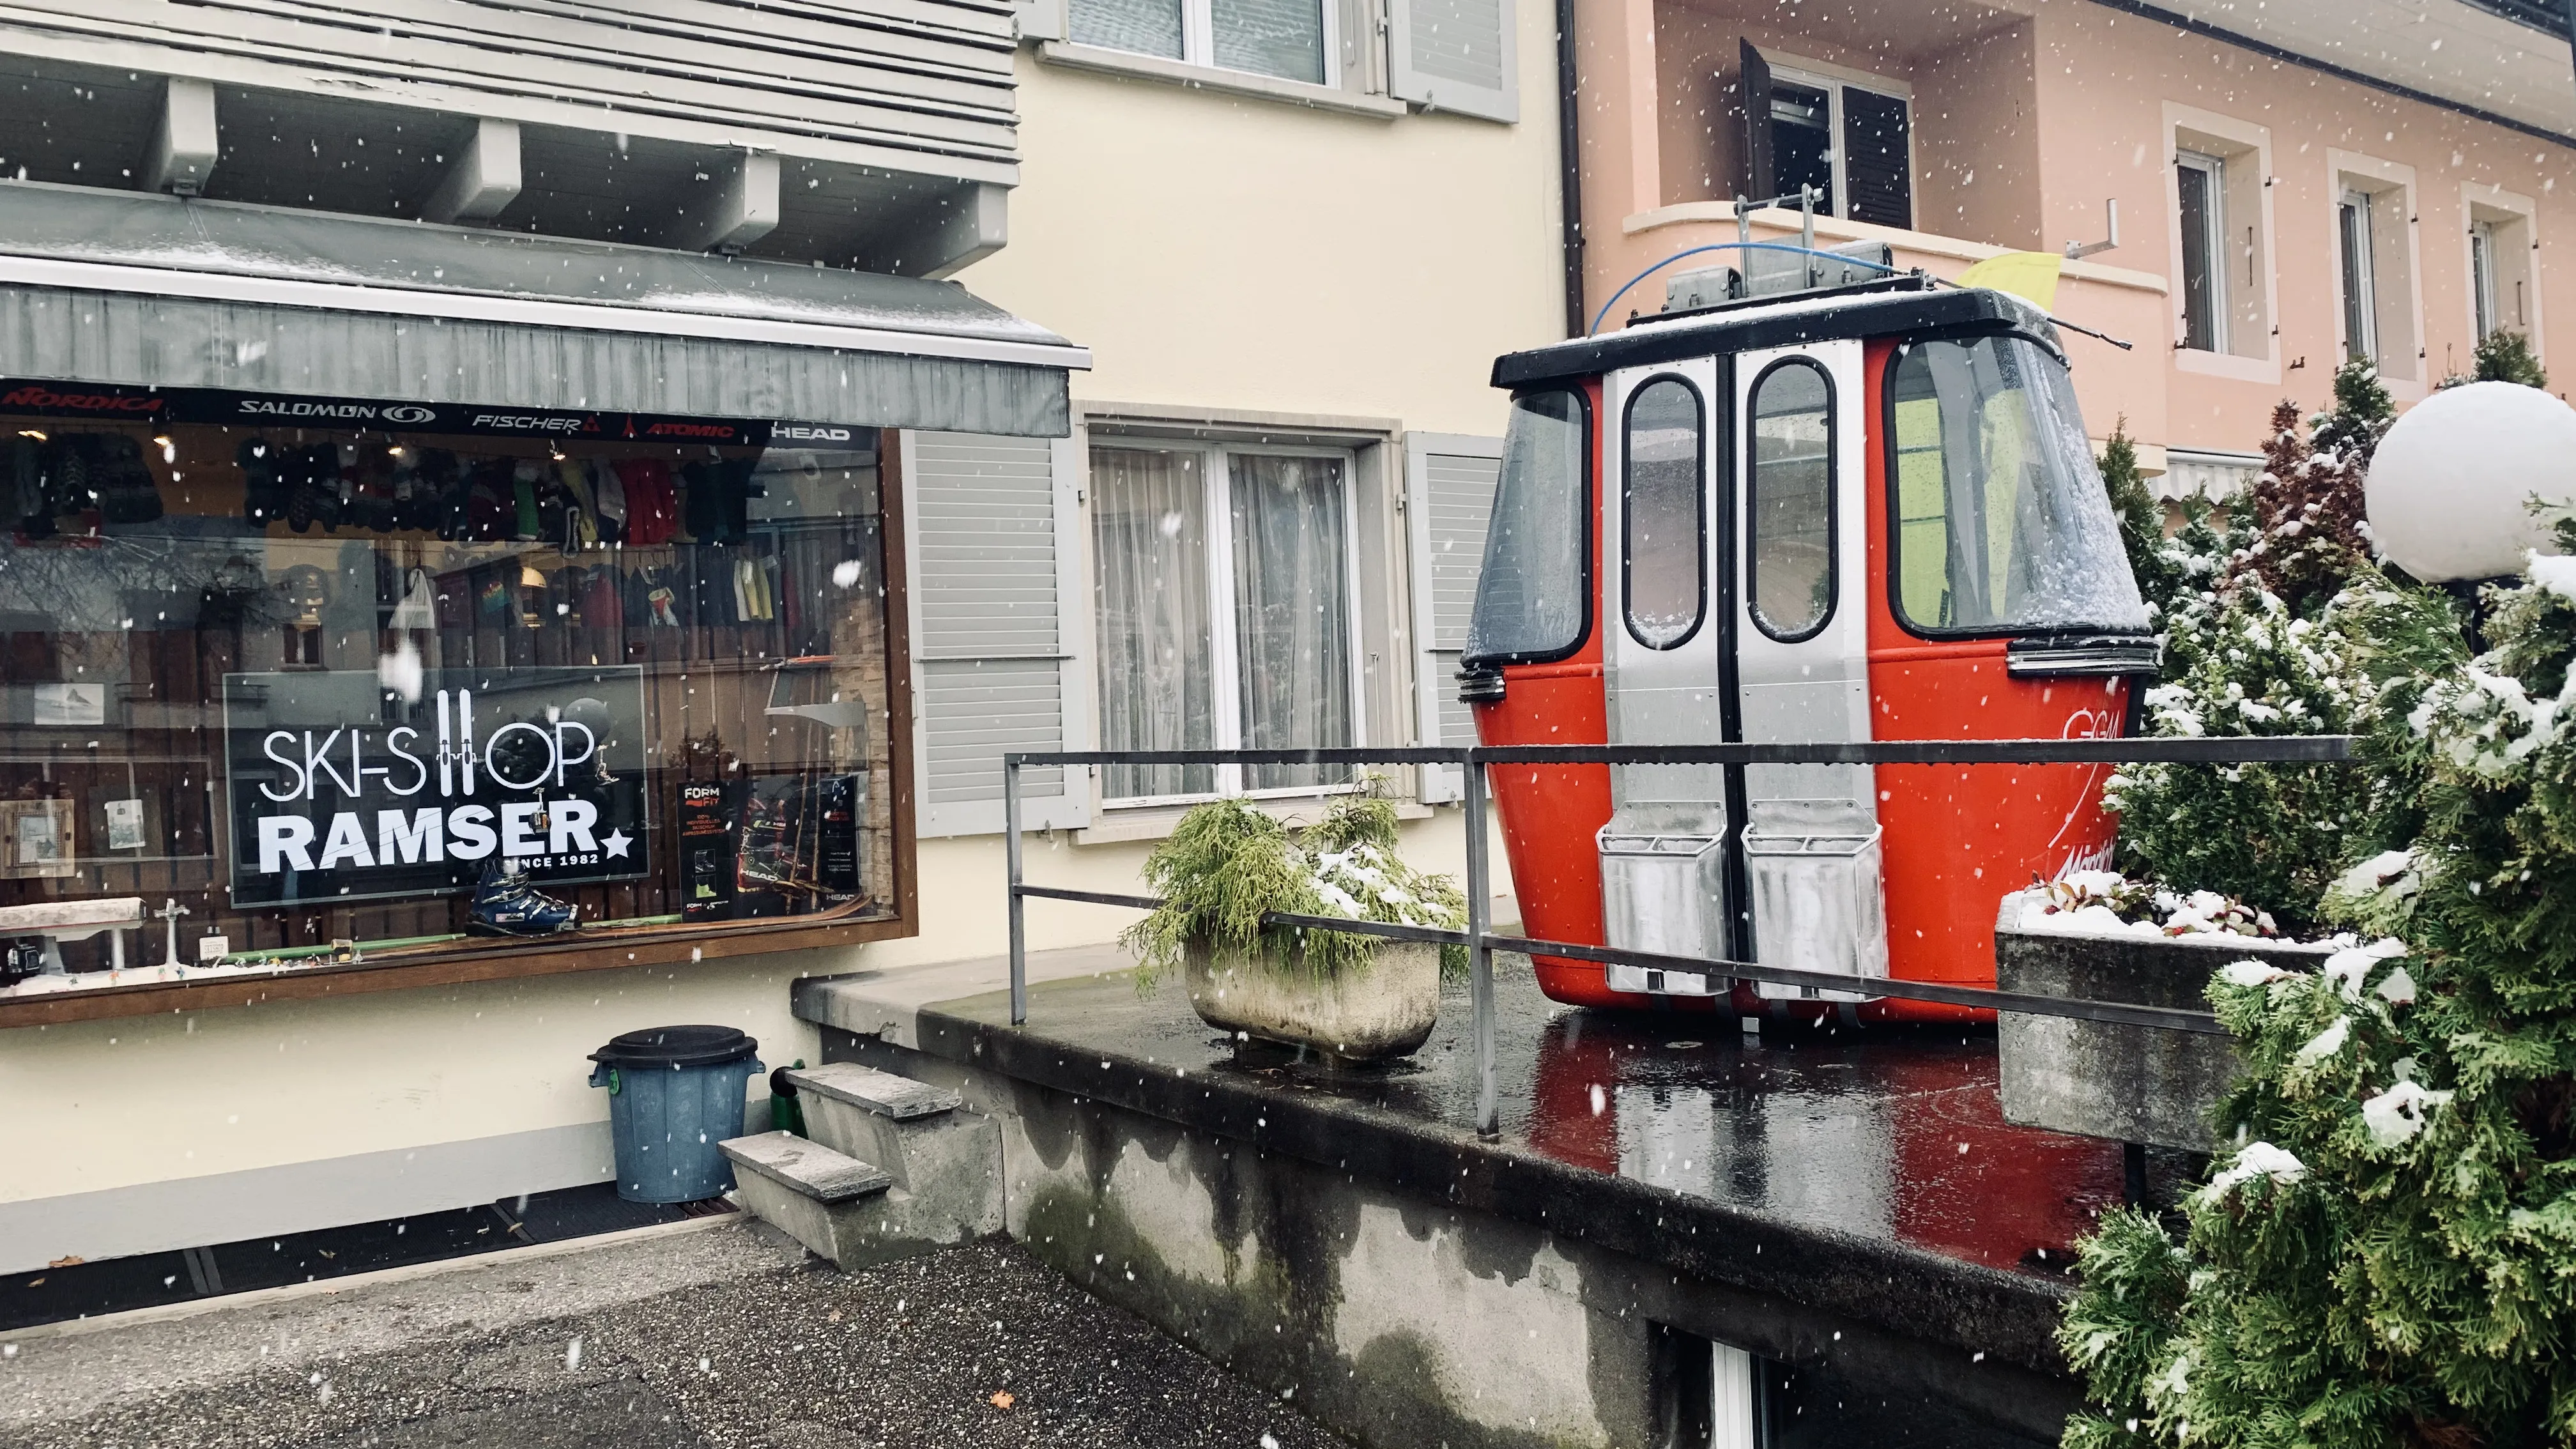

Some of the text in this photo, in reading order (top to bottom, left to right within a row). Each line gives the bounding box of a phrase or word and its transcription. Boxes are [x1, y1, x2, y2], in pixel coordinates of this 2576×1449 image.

[2, 387, 164, 411] NORDICA
[238, 401, 376, 418] SALOMON
[472, 415, 582, 431] FISCHER
[645, 423, 735, 438] ATOMIC
[771, 425, 850, 441] HEAD
[259, 689, 595, 802] SKI-SHOP
[684, 787, 719, 799] FORM
[257, 800, 599, 873] RAMSER
[560, 854, 598, 866] 1982
[740, 868, 778, 882] HEAD
